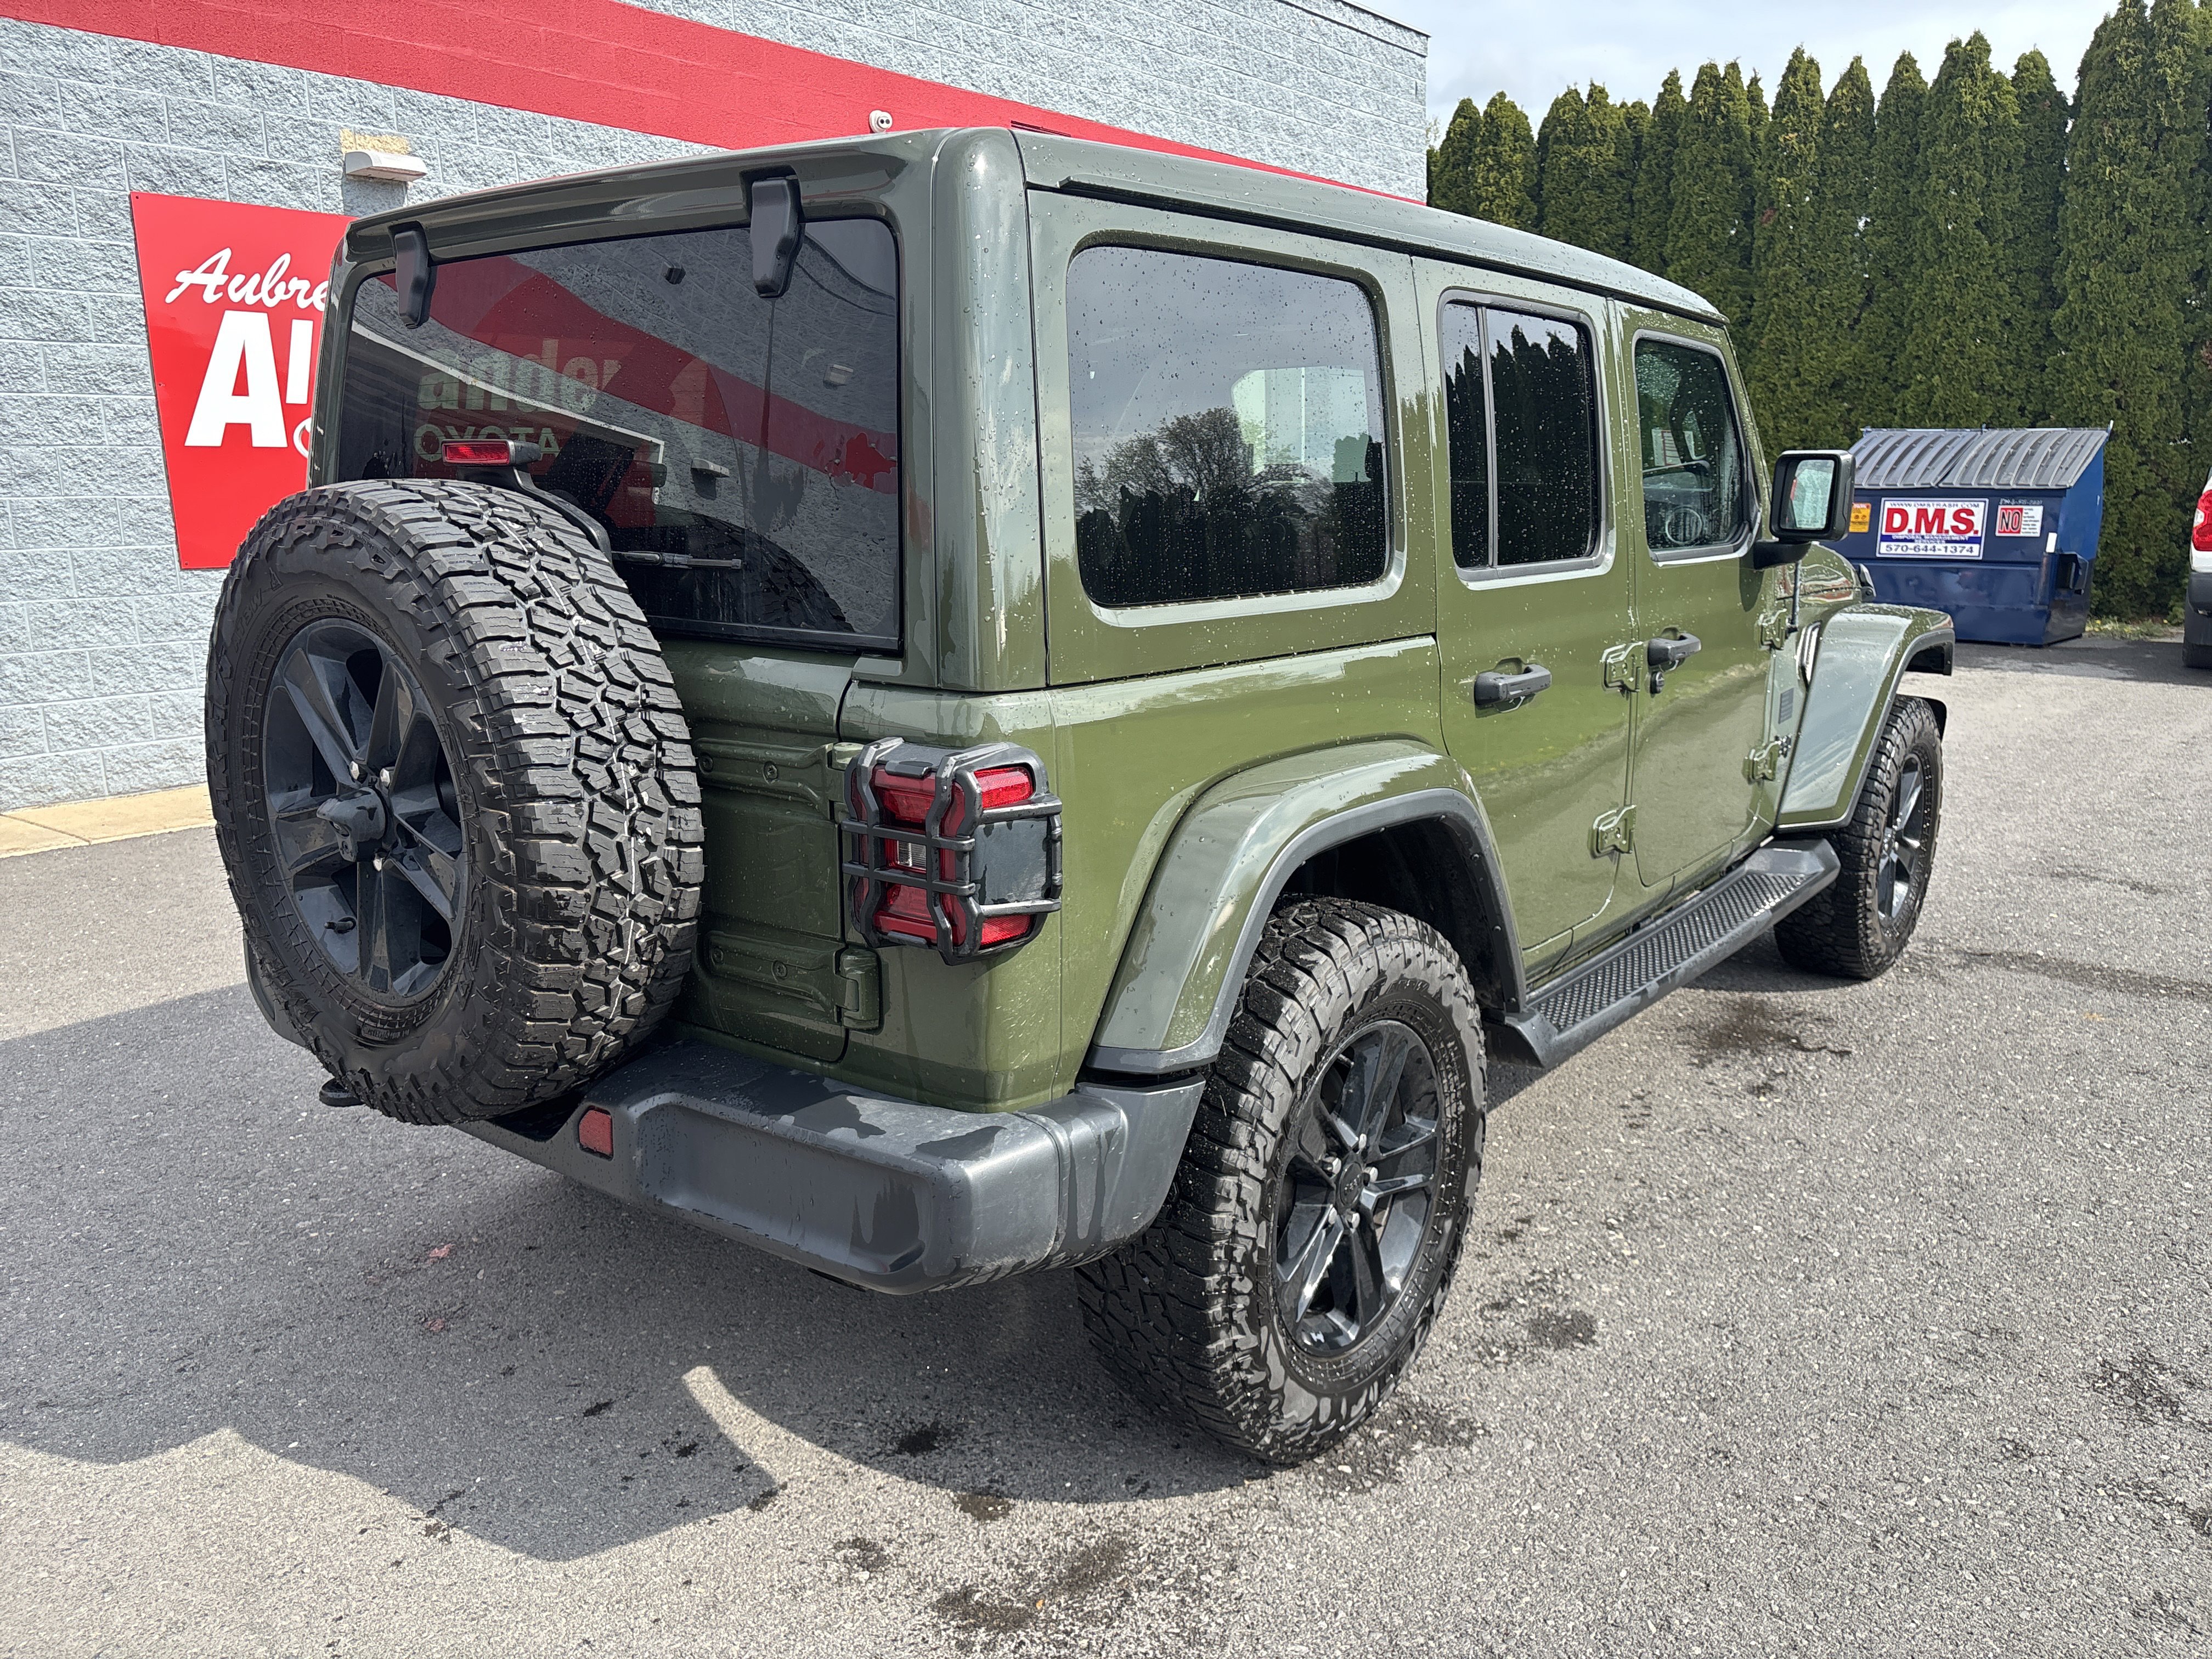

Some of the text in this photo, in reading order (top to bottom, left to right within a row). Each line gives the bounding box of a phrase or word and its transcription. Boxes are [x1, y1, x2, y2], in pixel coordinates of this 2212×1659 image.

[1885, 508, 1978, 534] D.M.S.
[1999, 509, 2022, 532] NO
[1885, 544, 1974, 553] 570-644-1374
